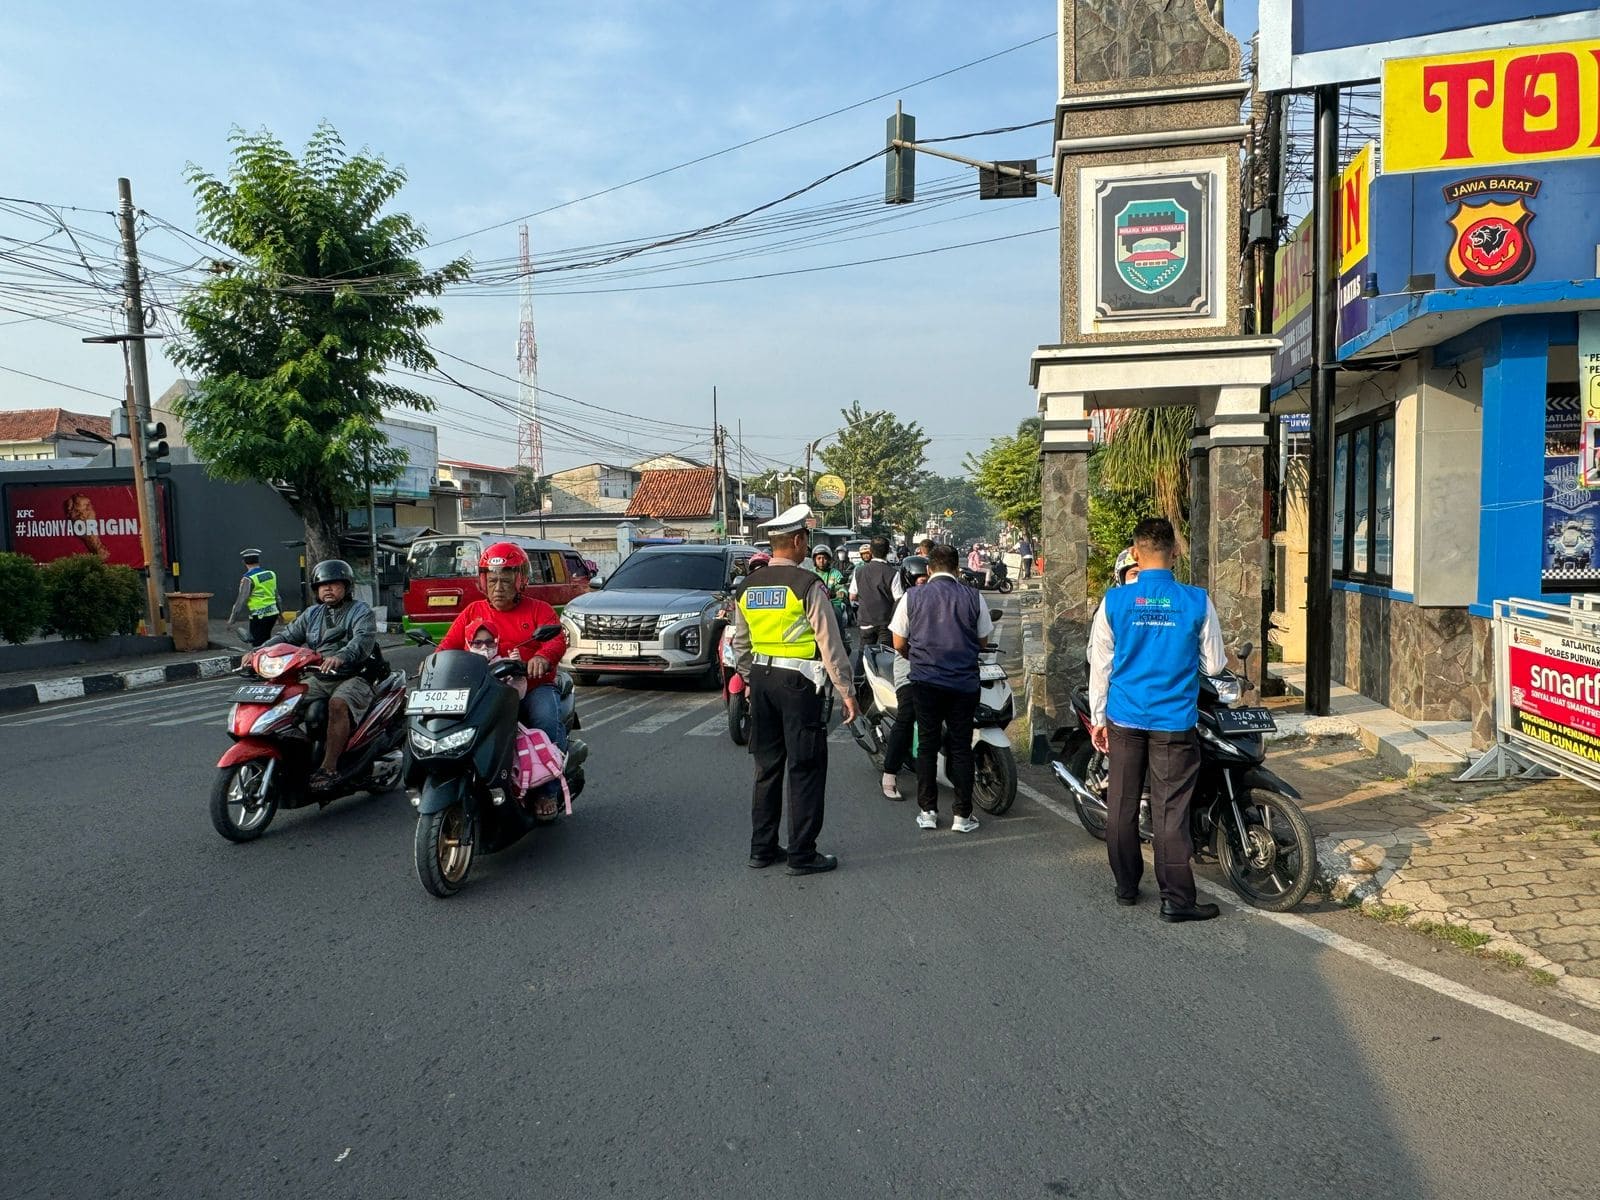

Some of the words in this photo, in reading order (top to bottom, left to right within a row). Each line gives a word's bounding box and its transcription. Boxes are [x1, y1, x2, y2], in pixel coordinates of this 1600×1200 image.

[1423, 50, 1600, 160] TO
[1452, 181, 1487, 197] JAWA
[1489, 179, 1533, 192] BARAT
[16, 509, 34, 518] KFC
[15, 518, 143, 538] #JAGONYAORIGIN
[746, 590, 785, 606] POLISI
[1545, 647, 1569, 660] POLRES
[412, 692, 419, 702] T
[425, 692, 448, 702] 5402
[455, 691, 467, 701] JE
[1522, 722, 1552, 743] WAJIB
